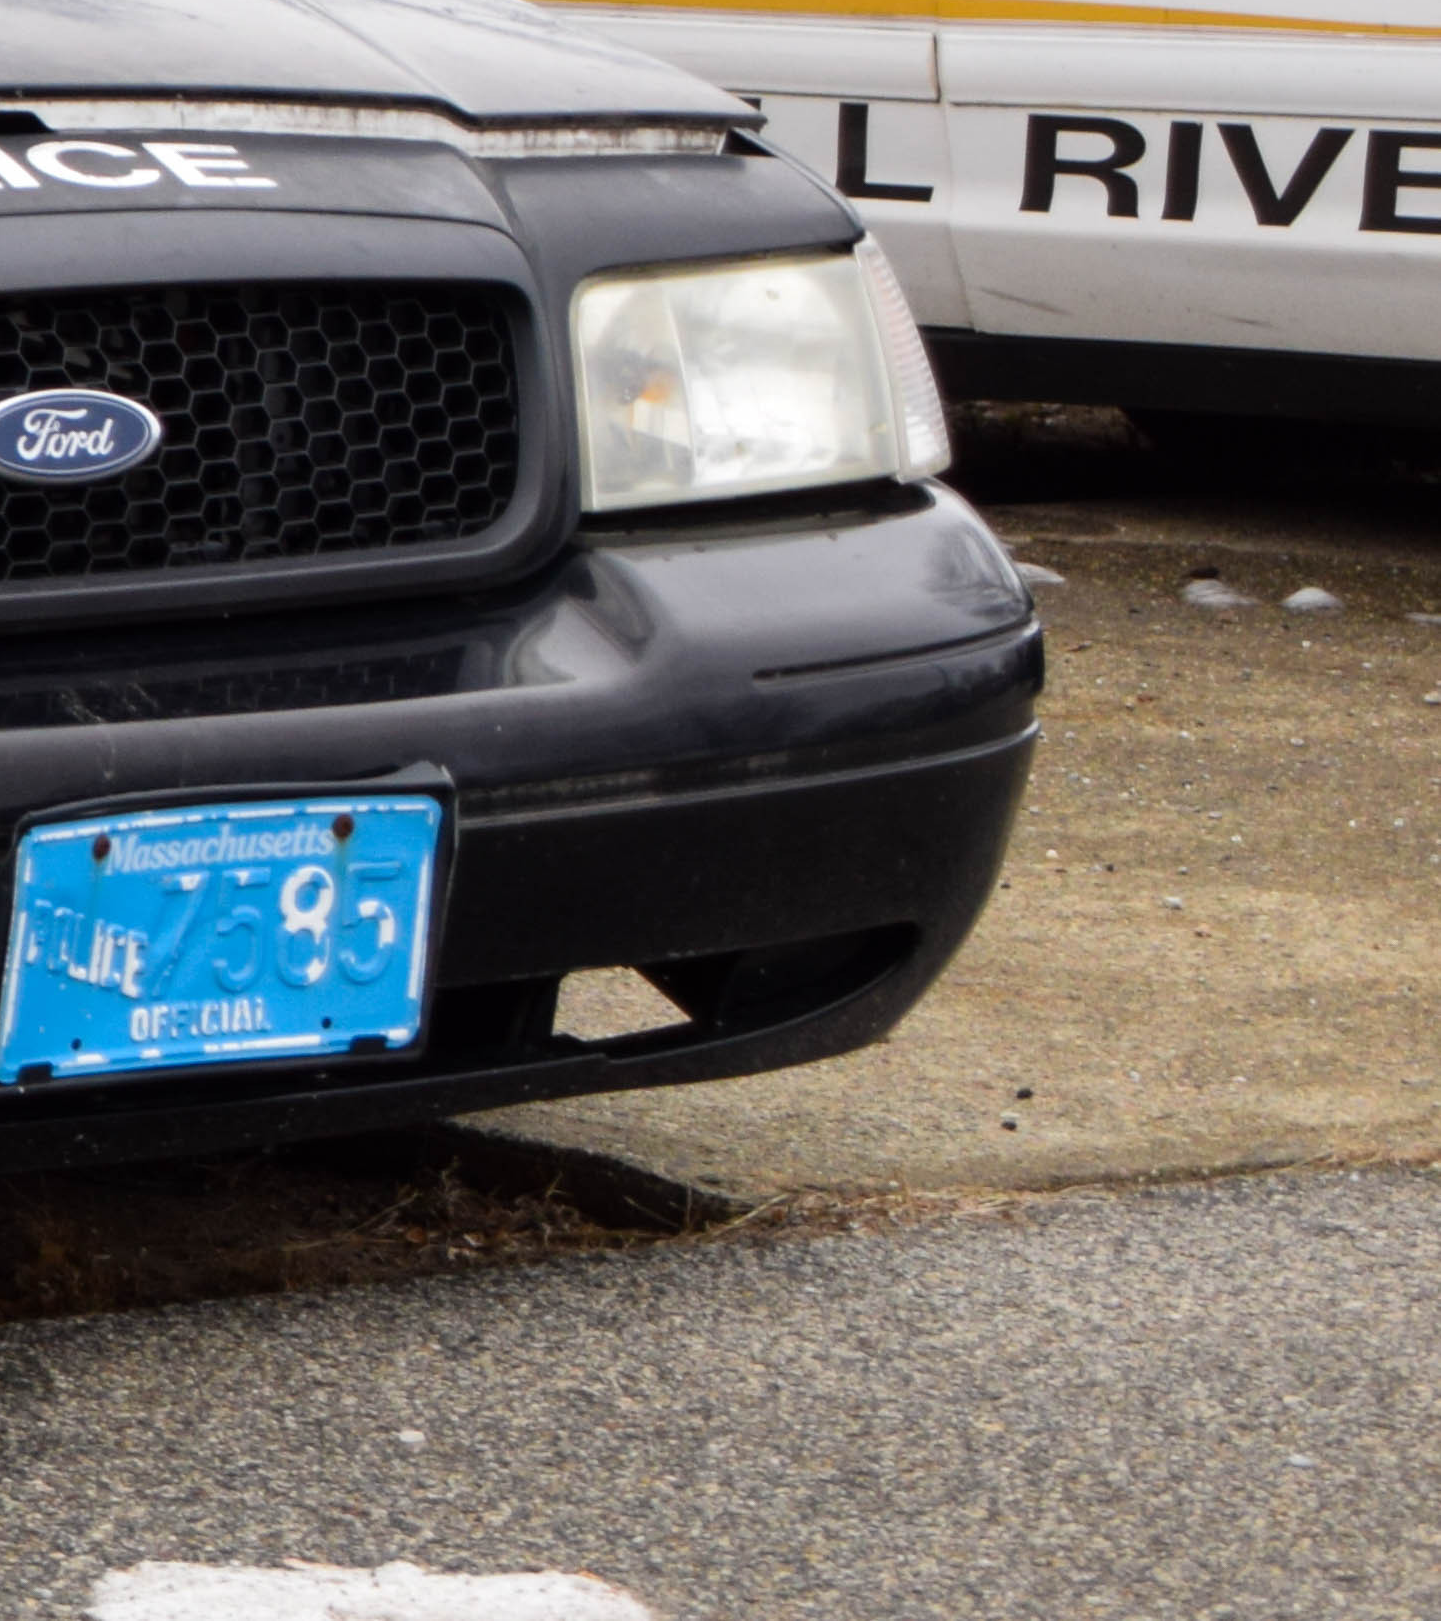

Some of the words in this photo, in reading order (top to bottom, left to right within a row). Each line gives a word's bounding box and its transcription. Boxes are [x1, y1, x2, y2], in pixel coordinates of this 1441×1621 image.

[16, 408, 115, 461] Ford
[105, 824, 335, 875] Massachusetts
[26, 898, 148, 999] POLICE
[129, 997, 274, 1042] OFFICIAL
